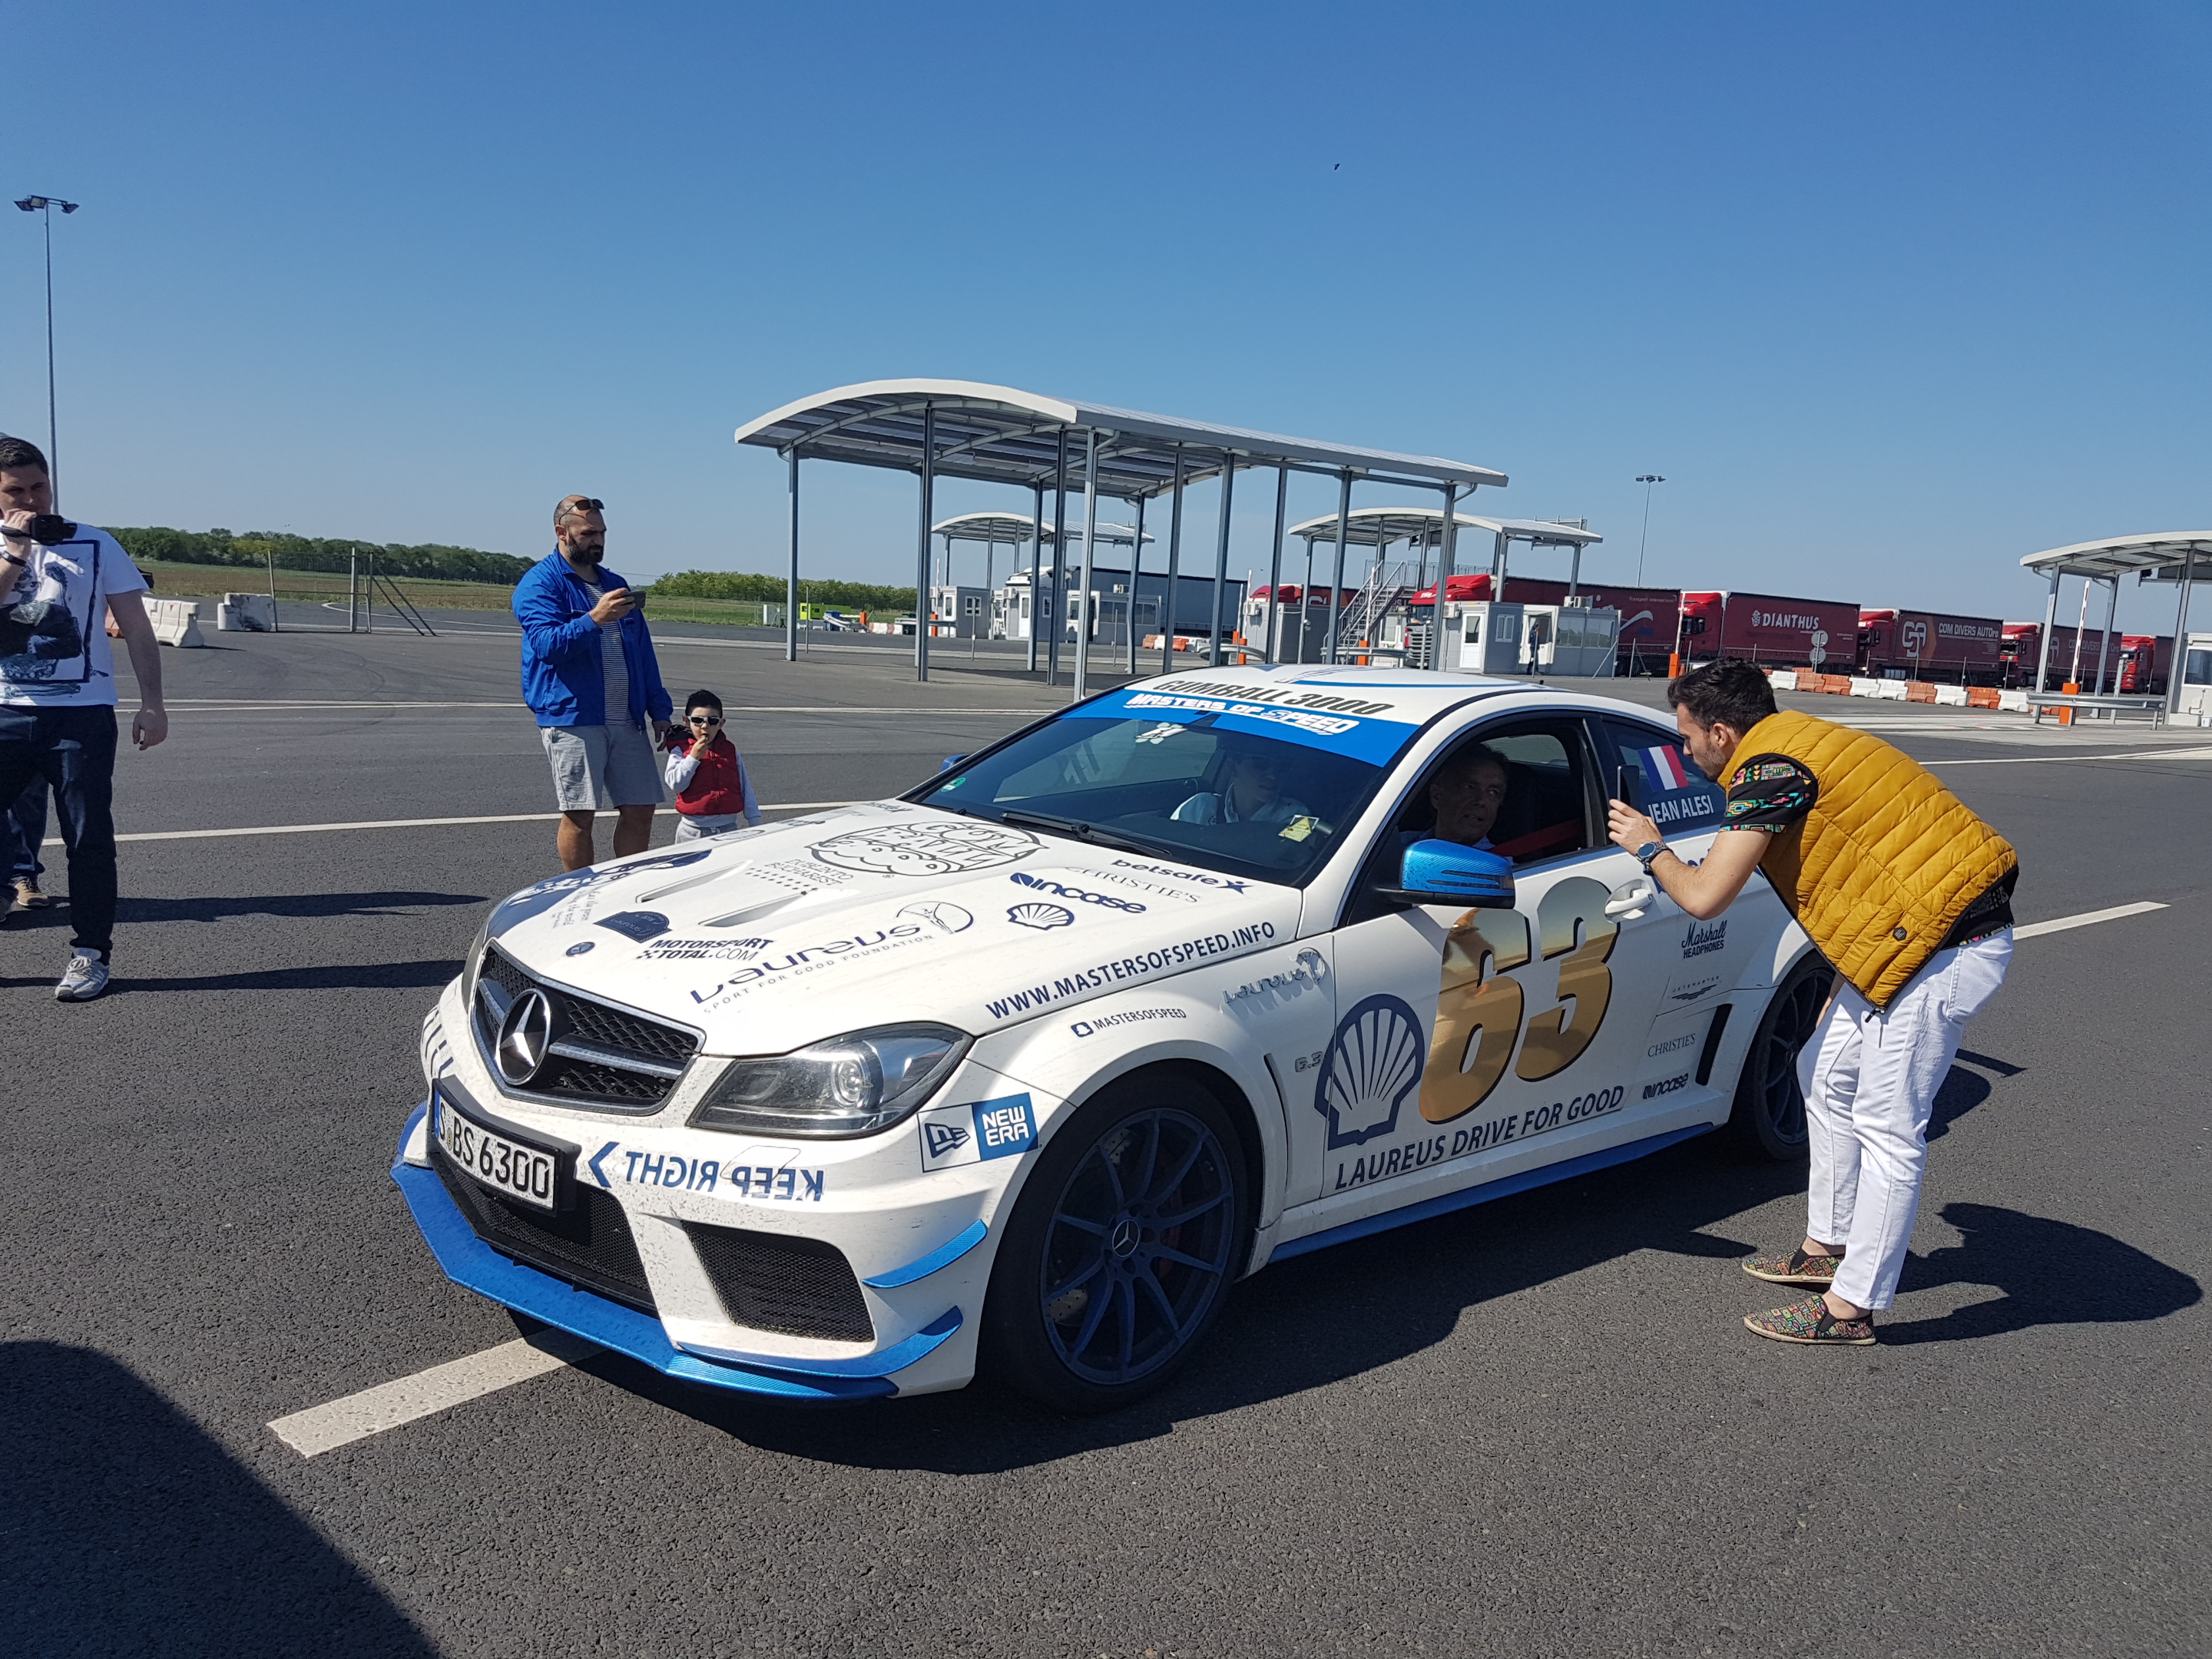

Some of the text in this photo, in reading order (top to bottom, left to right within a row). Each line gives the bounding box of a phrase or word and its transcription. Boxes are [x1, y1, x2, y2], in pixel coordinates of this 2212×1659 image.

[1762, 612, 1820, 630] DIANTHUS
[1939, 622, 1954, 634] COM
[1954, 624, 1976, 637] DIVERS
[1153, 680, 1395, 716] GUMBALL 3000
[1126, 693, 1360, 734] MASTERS OF SPEED
[1682, 794, 1714, 819] ALESI
[1065, 866, 1200, 903] CHRISTIE'S
[1111, 859, 1220, 886] betsafe
[1030, 878, 1147, 914] incase
[650, 937, 774, 949] MOTORSPORT
[1681, 919, 1728, 949] Marshall
[657, 946, 759, 962] TOTAL.COM
[1683, 939, 1724, 959] HEADPHONES
[704, 933, 934, 1015] SPORT FOR GOOD FOUNDATION
[985, 920, 1276, 1020] WWW.MASTERSOFSPEED.INFO
[1419, 876, 1621, 1125] 63
[1093, 1008, 1187, 1031] MASTERSOFSPEED
[982, 1105, 1026, 1131] NEW
[985, 1122, 1031, 1147] ERA
[1334, 1084, 1624, 1190] LAUREUS DRIVE FOR GOOD
[439, 1101, 550, 1200] S BS 6300
